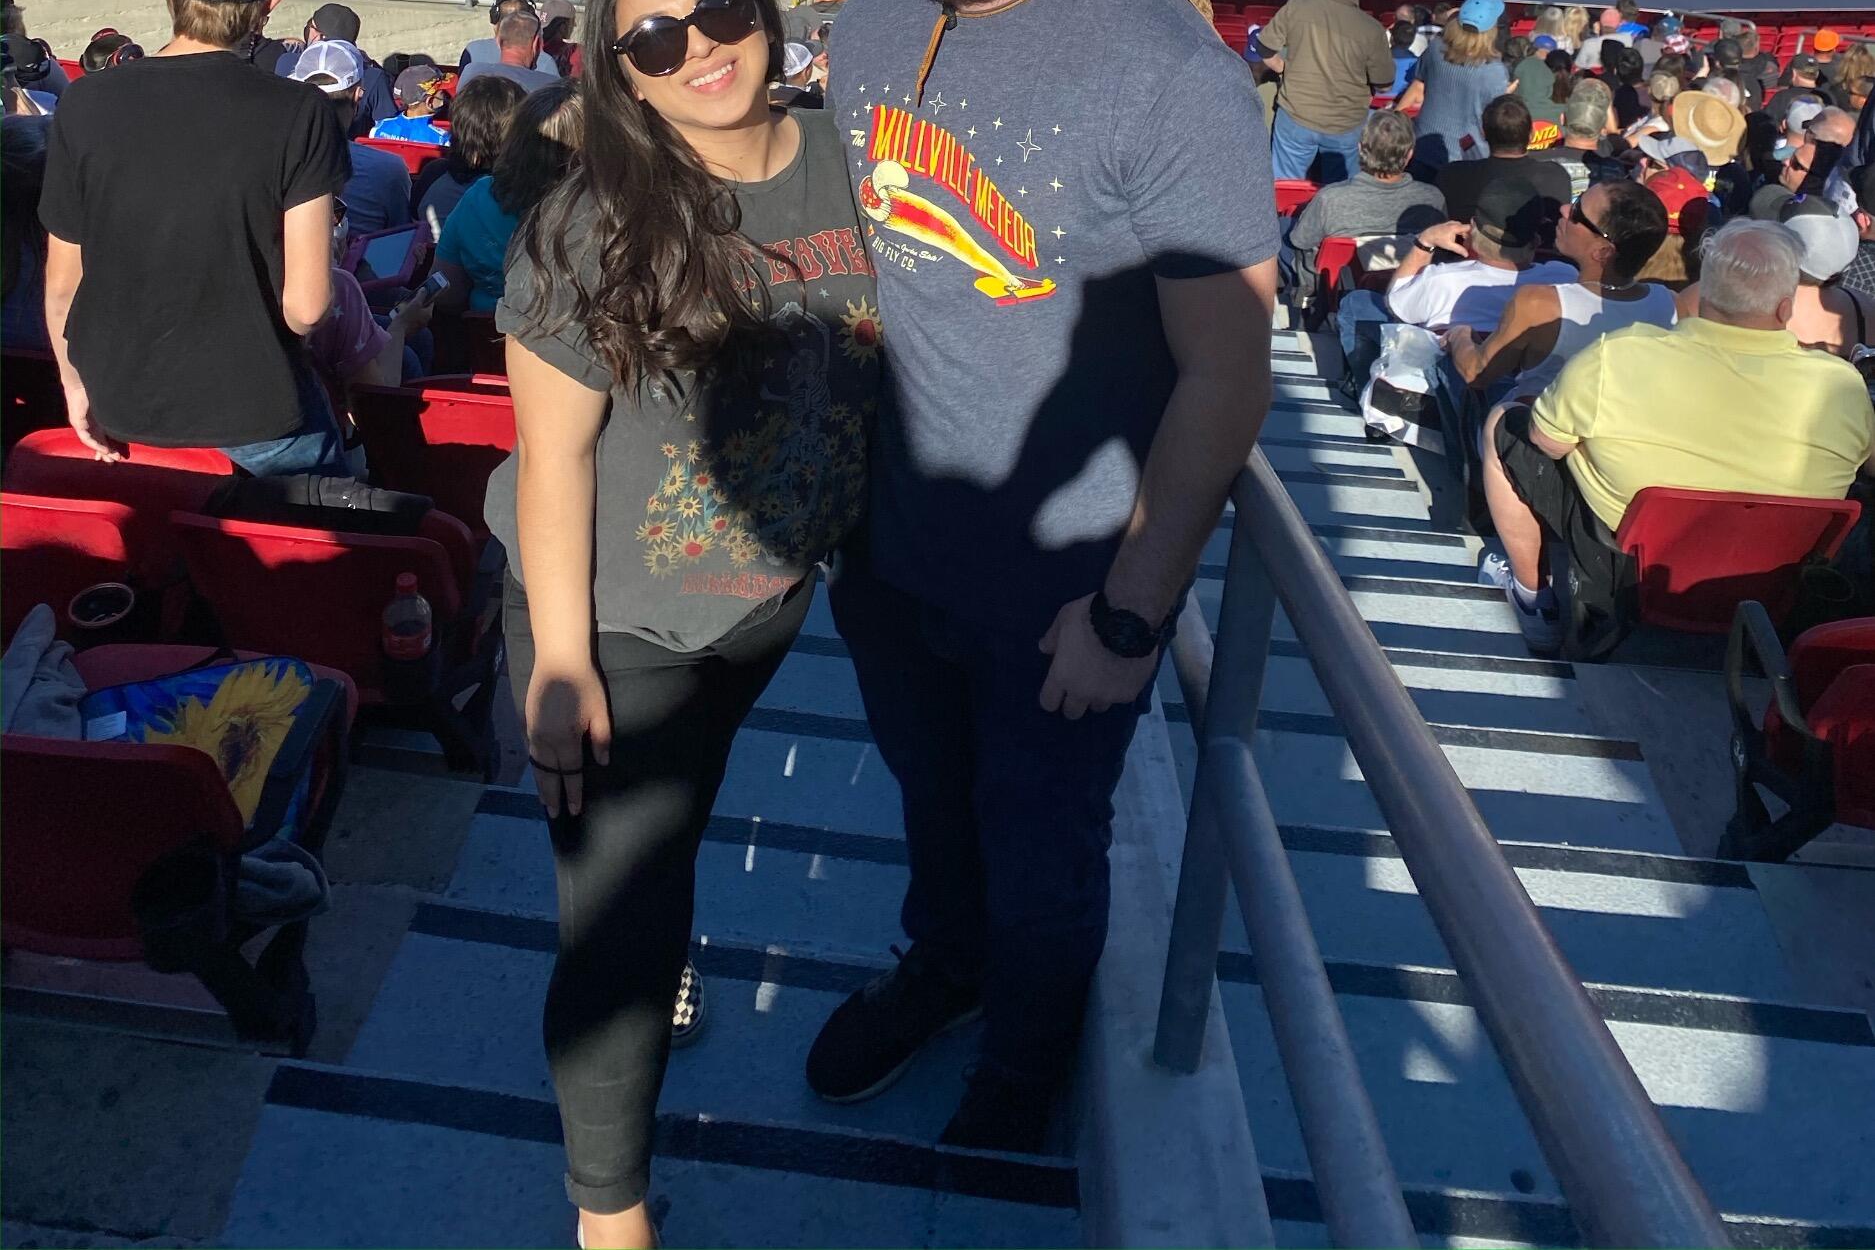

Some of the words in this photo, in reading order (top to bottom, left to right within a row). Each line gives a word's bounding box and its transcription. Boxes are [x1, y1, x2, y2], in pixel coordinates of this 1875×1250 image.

[850, 129, 866, 148] The
[1531, 124, 1559, 142] NTA
[868, 104, 976, 206] MILLVILLE
[969, 167, 1040, 270] METEOR
[872, 236, 885, 253] BIG
[885, 246, 900, 263] FLY
